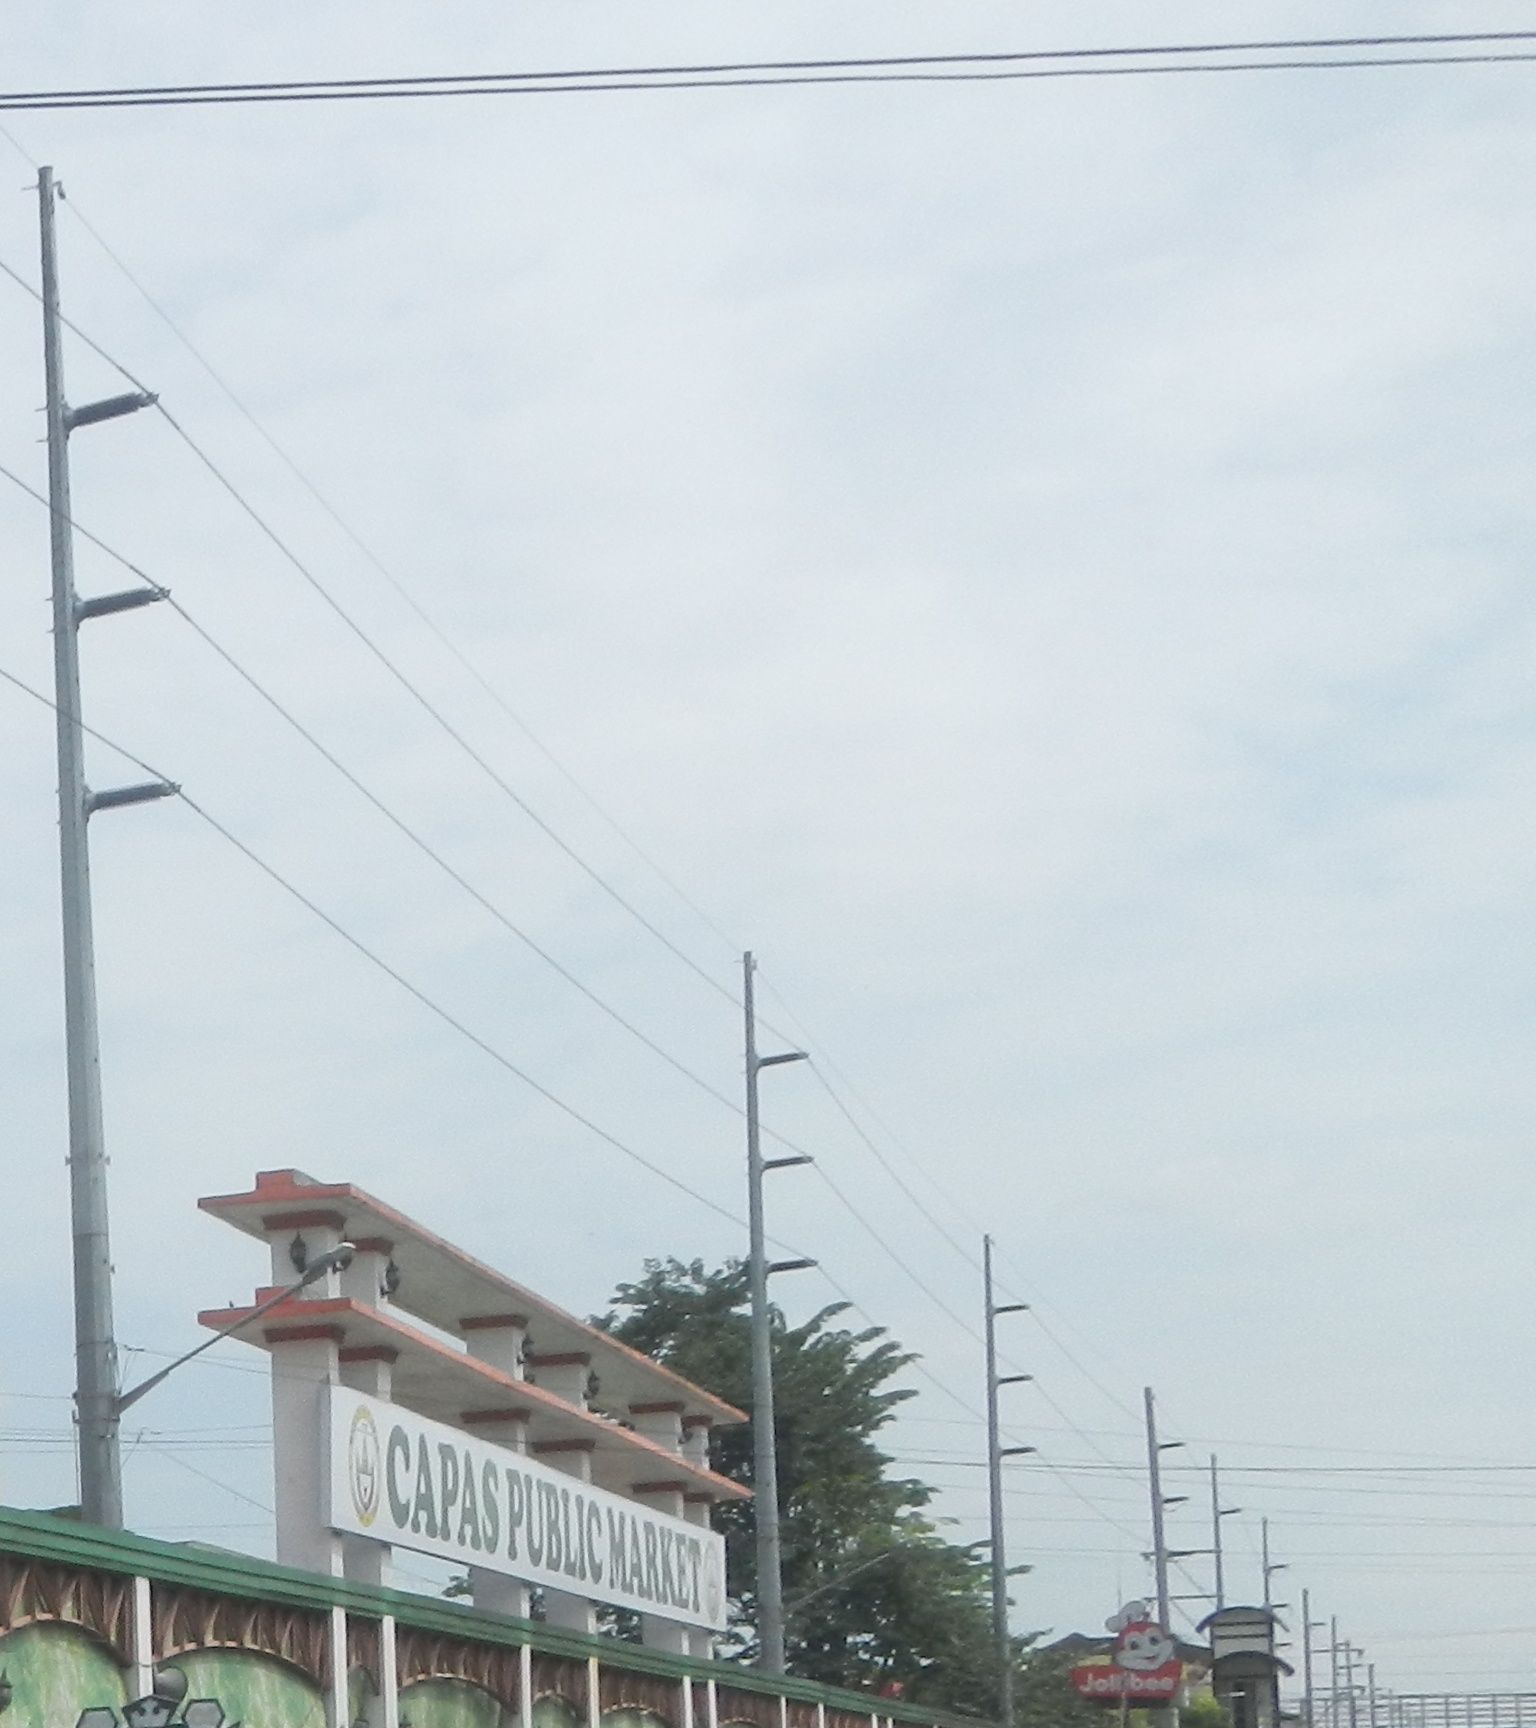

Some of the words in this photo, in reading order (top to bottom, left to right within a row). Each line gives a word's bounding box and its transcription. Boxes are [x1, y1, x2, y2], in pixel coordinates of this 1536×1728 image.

[386, 1425, 499, 1554] CAPAS
[506, 1468, 603, 1585] PUBLIC
[607, 1506, 702, 1614] MARKET
